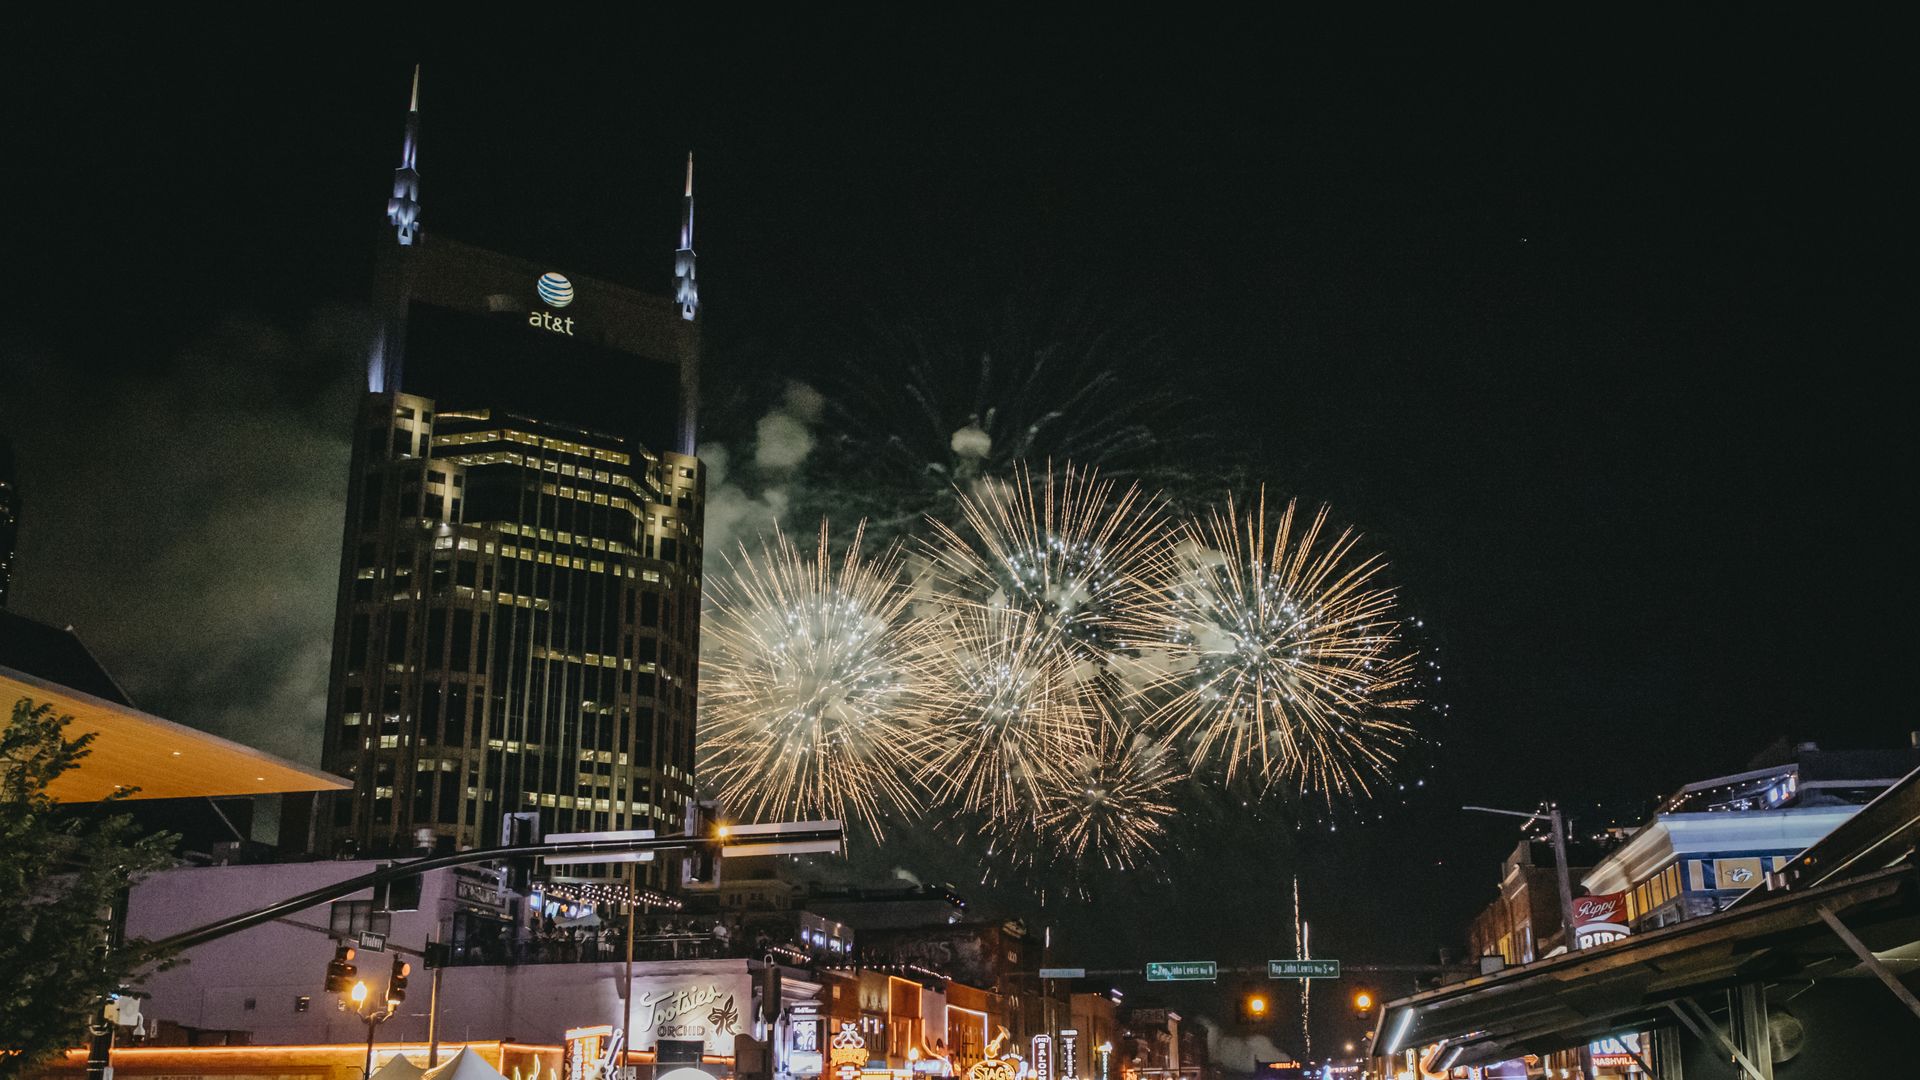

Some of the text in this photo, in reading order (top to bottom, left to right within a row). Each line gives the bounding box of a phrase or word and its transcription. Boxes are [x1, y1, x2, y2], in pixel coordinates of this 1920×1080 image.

[529, 311, 575, 336] at&t
[361, 932, 383, 949] Broadway
[1171, 965, 1183, 975] John
[1183, 965, 1199, 975] Lewis
[1284, 963, 1297, 973] John
[1297, 963, 1313, 973] Lewis
[657, 1025, 705, 1037] ORCHID
[1037, 1043, 1048, 1080] SALOON
[1593, 1056, 1638, 1066] NASHVILL
